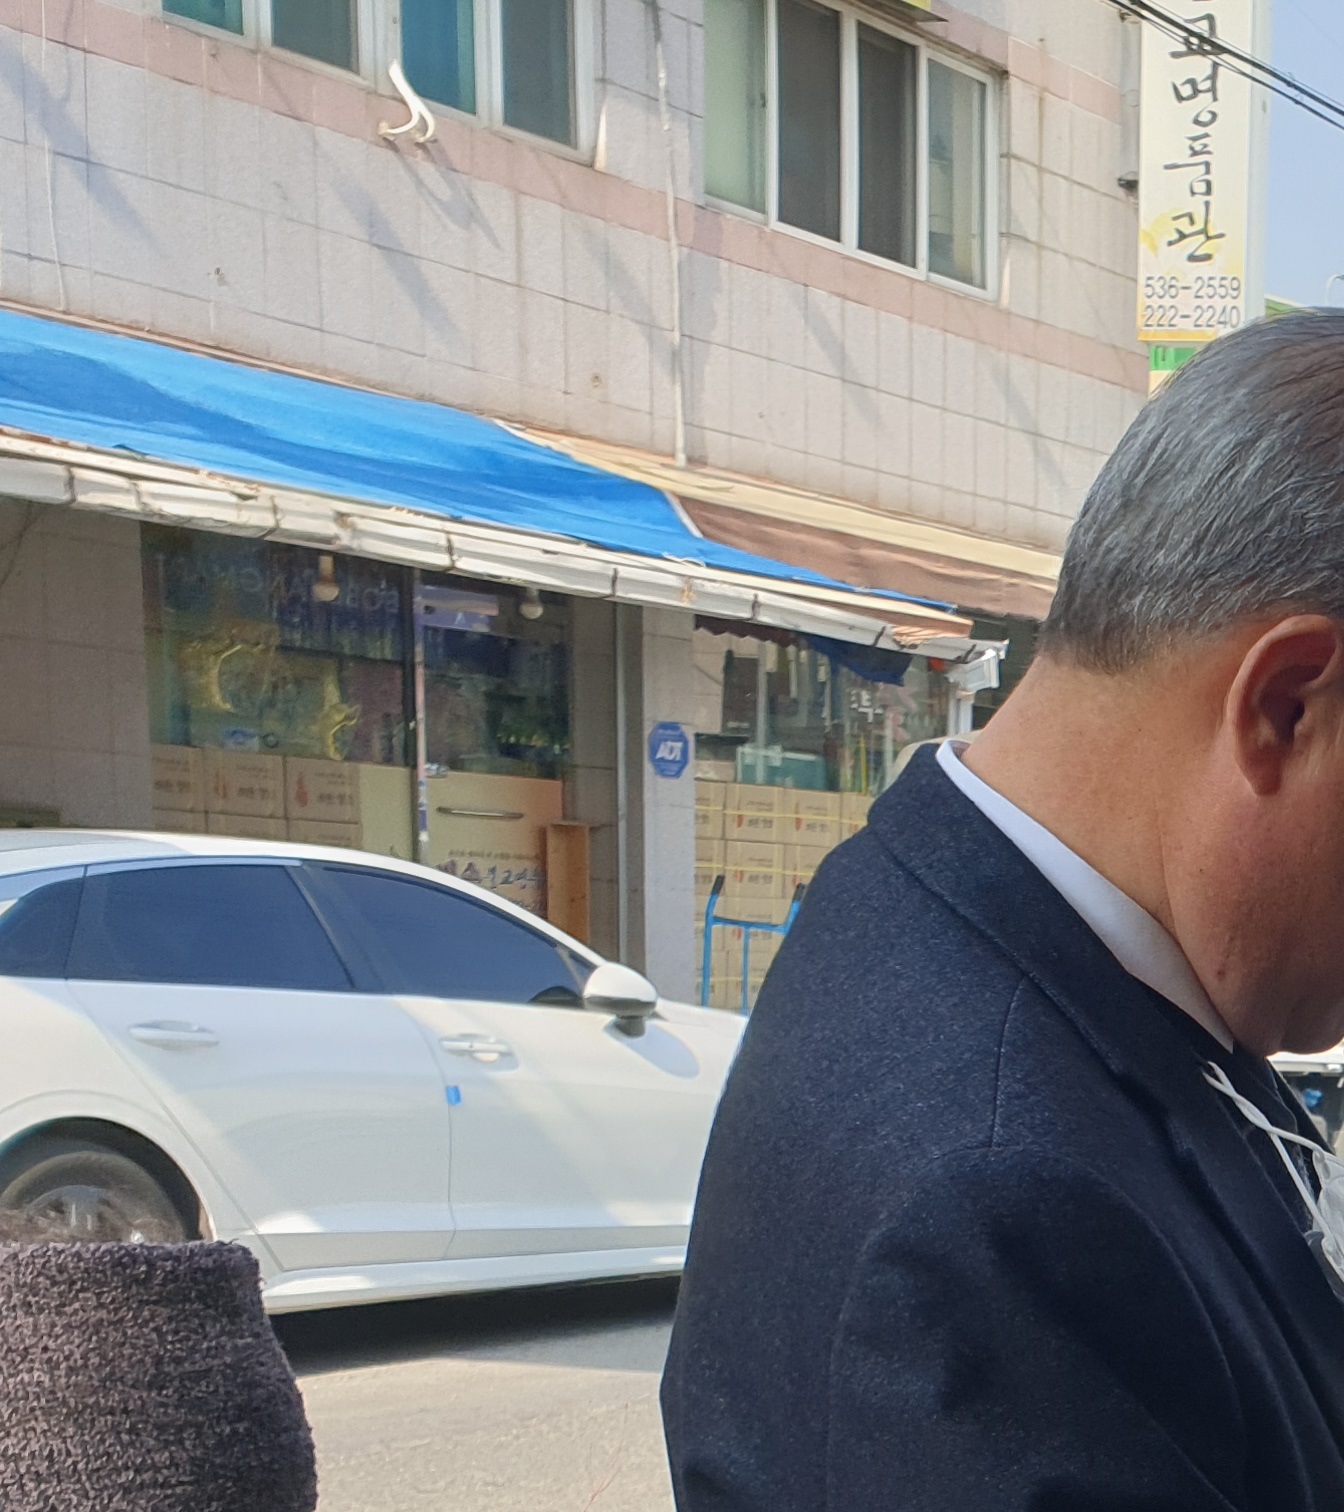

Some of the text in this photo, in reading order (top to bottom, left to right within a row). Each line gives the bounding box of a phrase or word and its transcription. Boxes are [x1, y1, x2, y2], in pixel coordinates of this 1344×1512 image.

[1143, 276, 1242, 300] 536-2559
[1142, 304, 1242, 329] 222-2240
[655, 741, 684, 761] ADT
